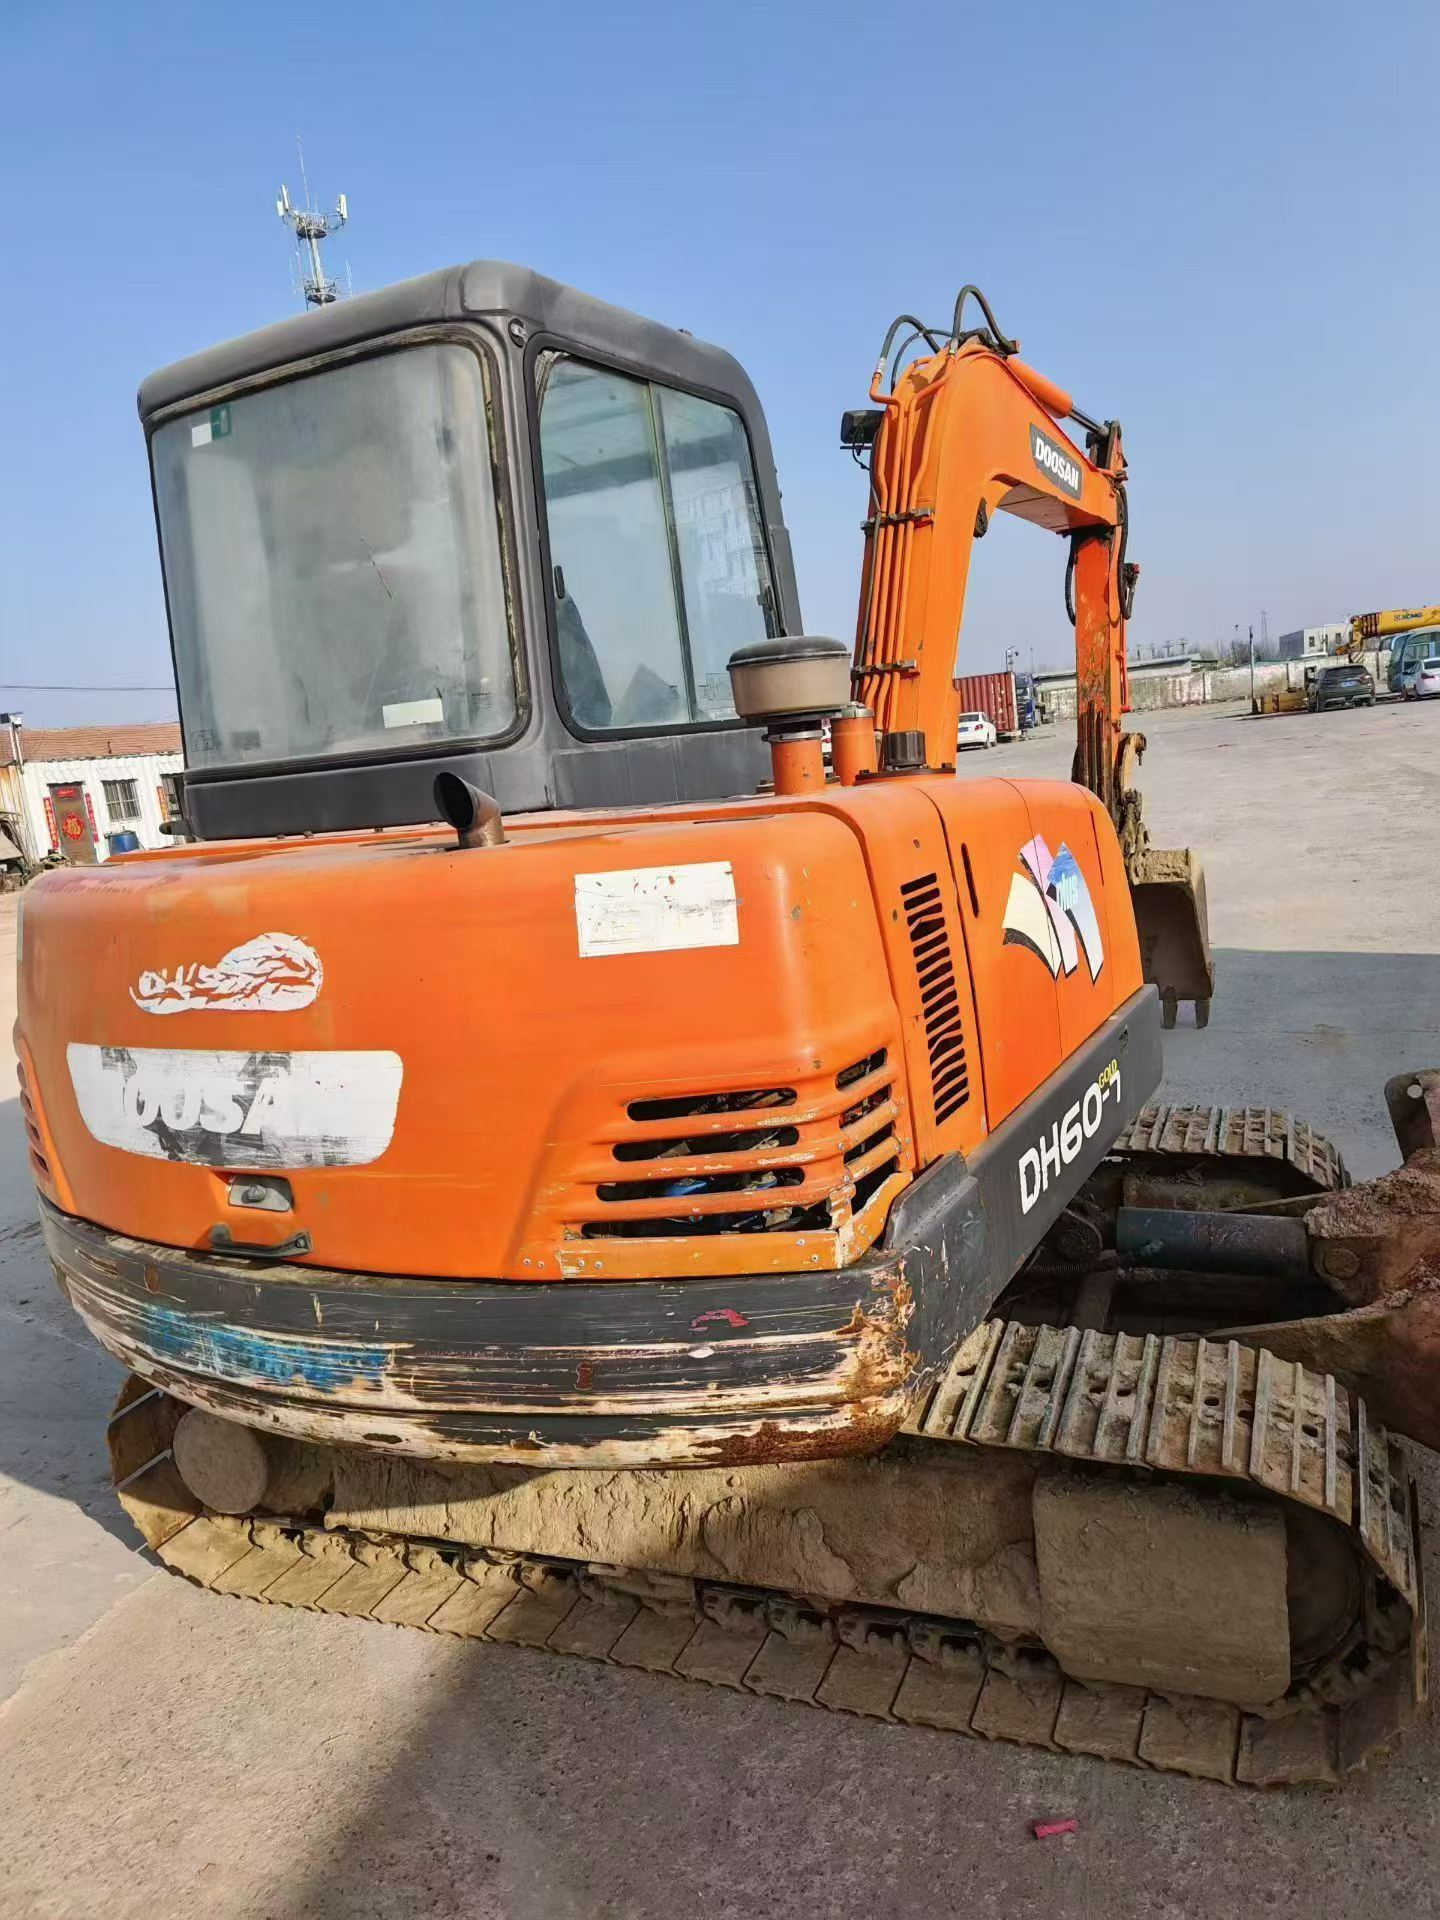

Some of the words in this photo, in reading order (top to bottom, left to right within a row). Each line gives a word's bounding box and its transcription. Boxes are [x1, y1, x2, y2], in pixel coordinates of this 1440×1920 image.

[1035, 436, 1079, 491] DOOSAN
[1098, 1058, 1118, 1089] GOLD
[1018, 1069, 1121, 1215] DH60-7
